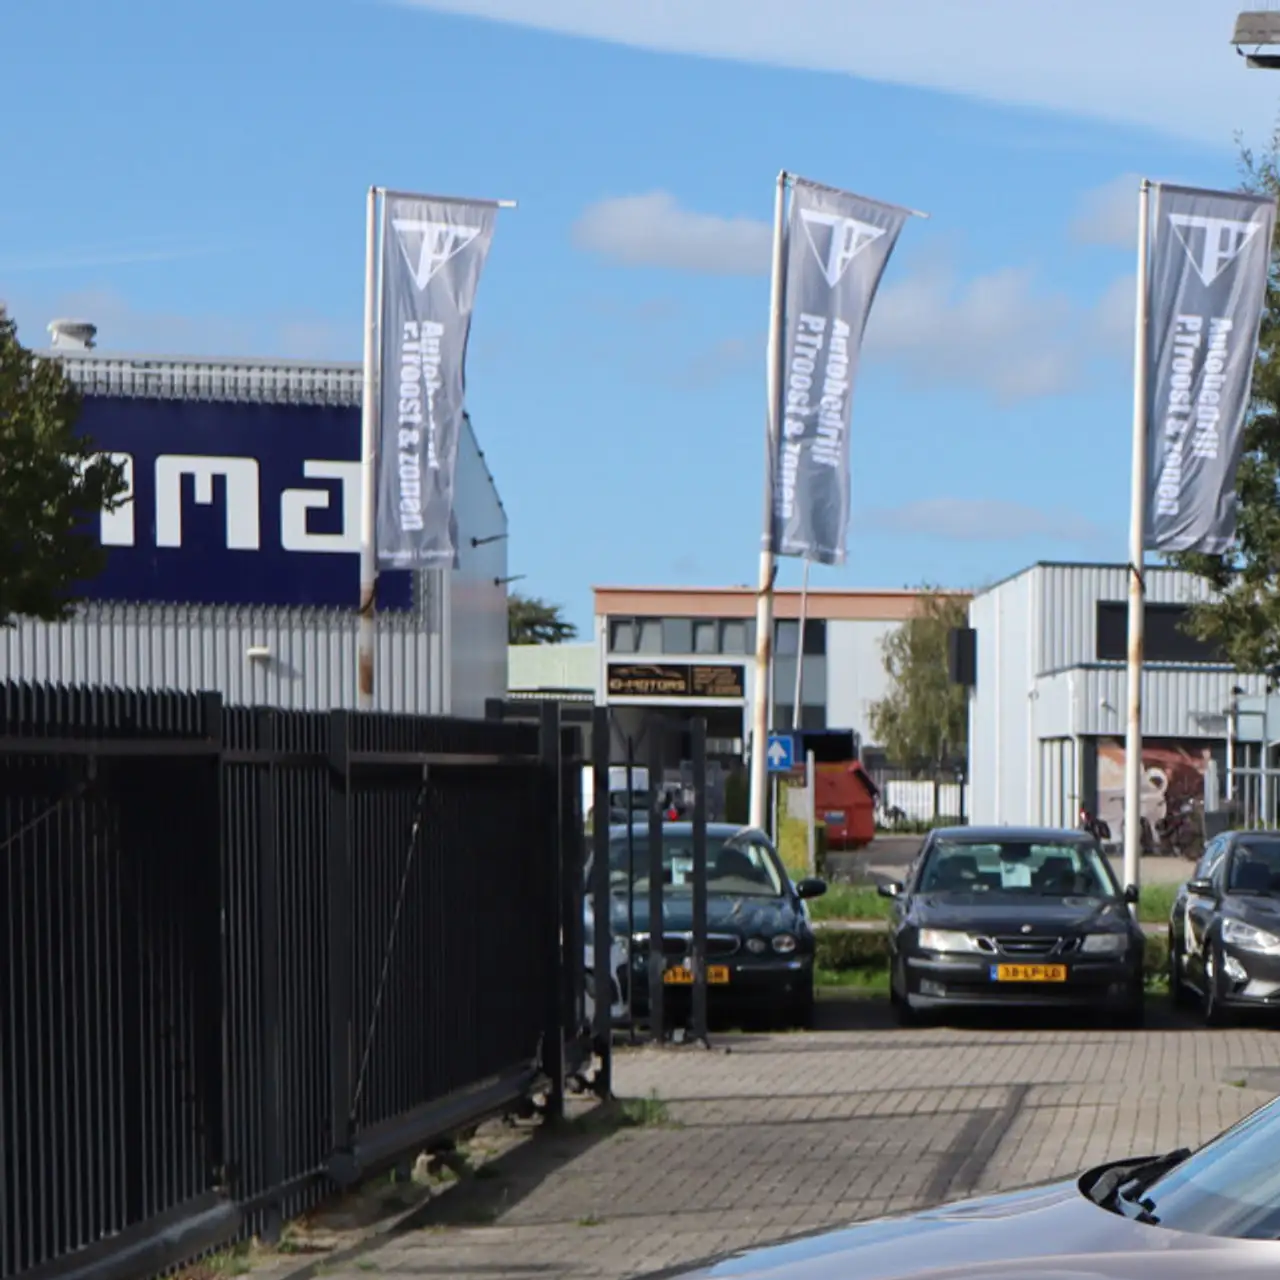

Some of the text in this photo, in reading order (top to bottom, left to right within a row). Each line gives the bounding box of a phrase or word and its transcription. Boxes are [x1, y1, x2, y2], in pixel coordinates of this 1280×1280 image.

[784, 312, 826, 416] P.Troost
[1167, 314, 1204, 414] P.Troost
[398, 427, 421, 449] &
[783, 418, 805, 437] &
